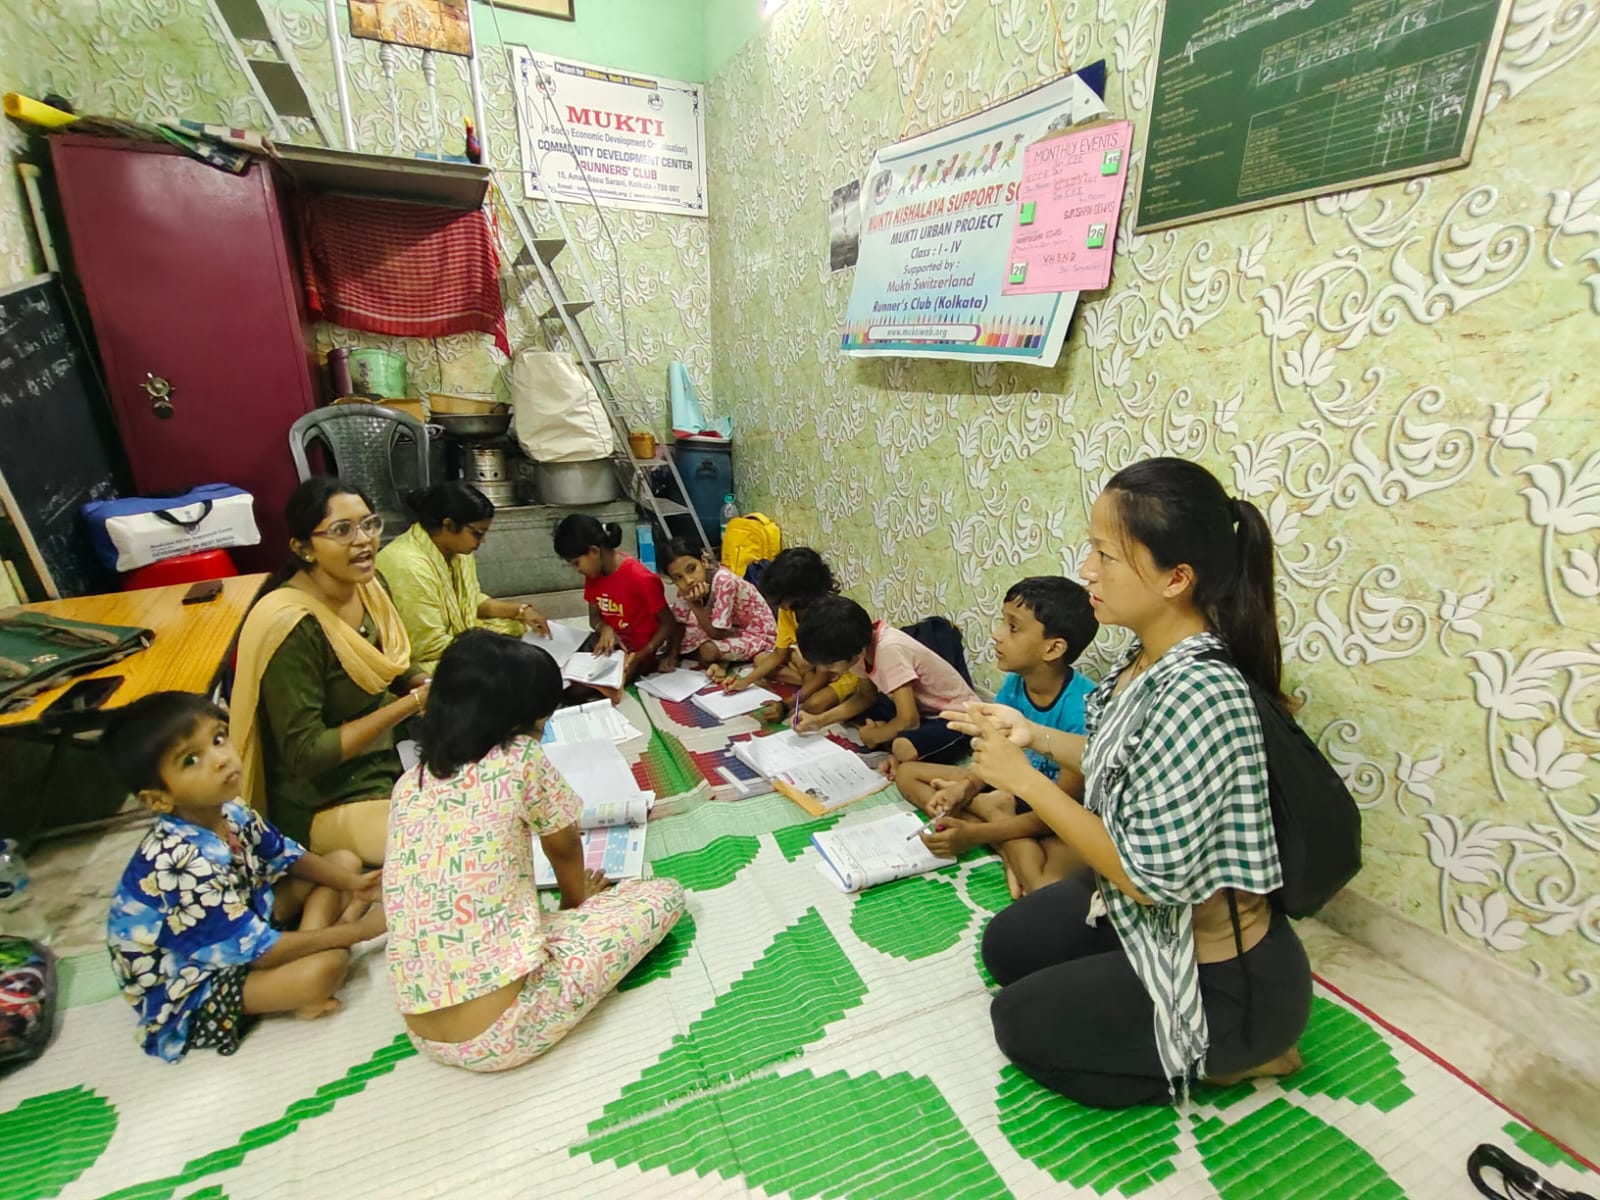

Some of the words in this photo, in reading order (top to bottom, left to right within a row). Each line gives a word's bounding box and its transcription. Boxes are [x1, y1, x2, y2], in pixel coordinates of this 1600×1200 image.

[566, 105, 665, 137] MUKTI
[571, 128, 604, 142] Economic
[605, 133, 646, 147] Development
[1034, 144, 1078, 164] MONTHLY
[1080, 132, 1119, 152] EVENTS
[633, 167, 657, 180] CLUB
[661, 157, 693, 170] CENTER
[893, 197, 945, 224] KISHALAYA
[947, 182, 1004, 213] SUPPORT
[890, 227, 918, 245] MUKTI
[920, 219, 953, 240] URBAN
[954, 213, 1004, 233] PROJECT
[911, 246, 931, 259] Class
[951, 239, 963, 254] IV
[903, 260, 943, 276] Supported
[944, 259, 954, 272] by
[886, 278, 911, 294] Mukti
[913, 272, 976, 291] Switzerland
[872, 299, 908, 313] Runner's
[910, 296, 931, 311] Club
[934, 294, 988, 313] (Kolkata)
